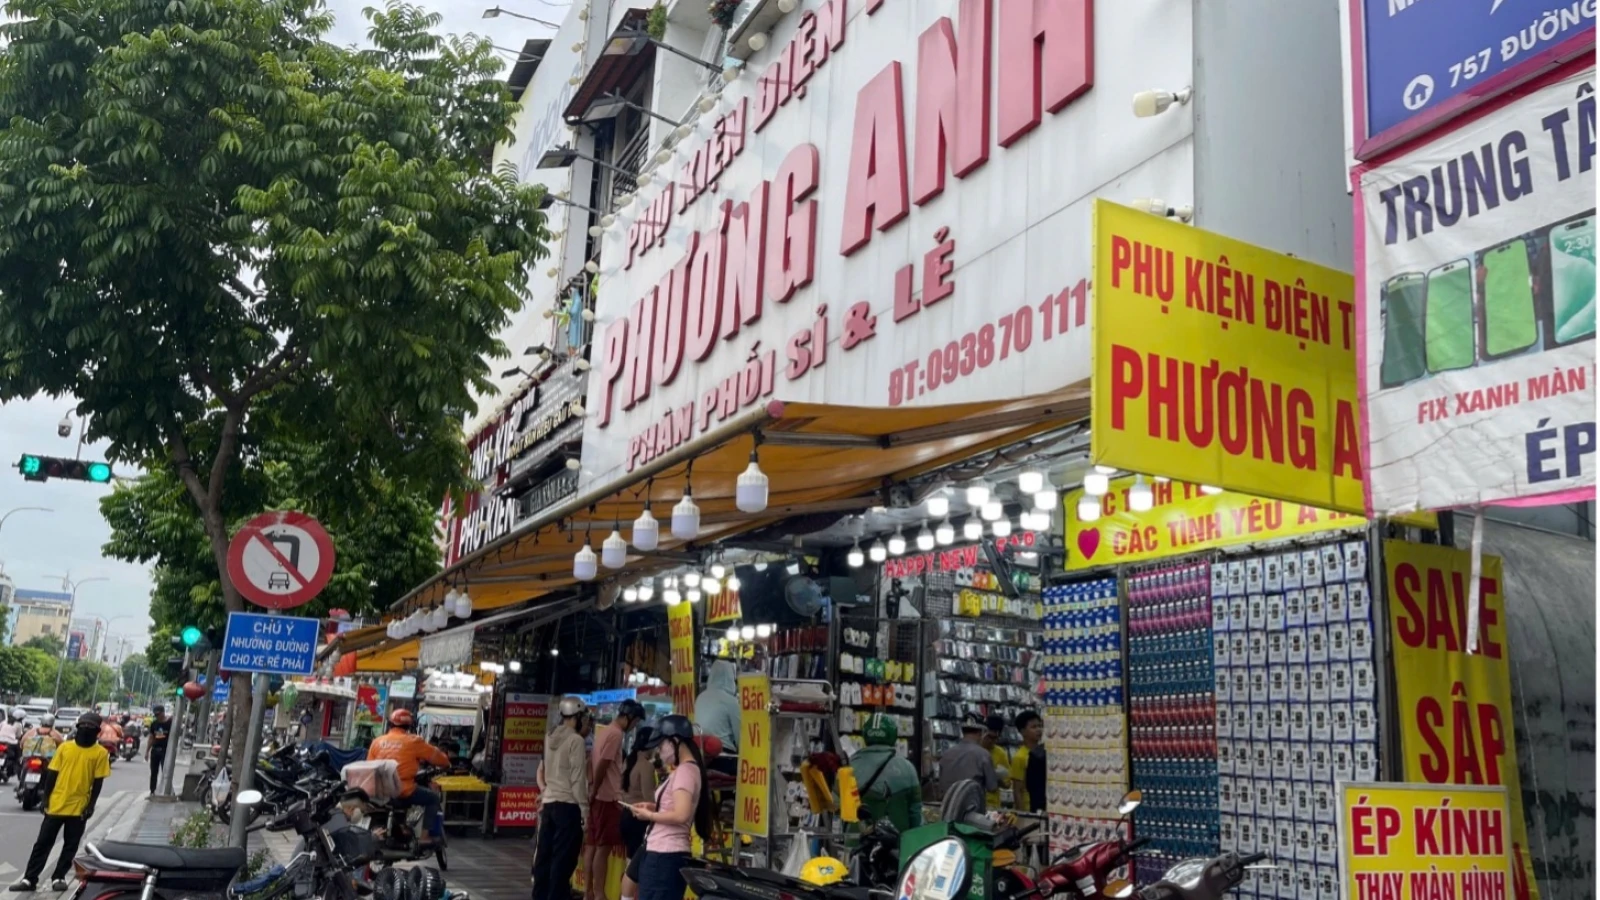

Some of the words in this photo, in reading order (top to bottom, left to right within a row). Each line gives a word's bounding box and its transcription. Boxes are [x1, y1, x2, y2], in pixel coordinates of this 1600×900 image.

[1448, 48, 1492, 88] 757
[1500, 0, 1596, 62] ĐƯỜNG
[624, 182, 674, 270] PHỤ
[678, 97, 747, 215] KIỆN
[754, 0, 846, 133] ĐIỆN
[596, 143, 820, 429] PHƯƠNG
[839, 0, 1095, 258] ANH
[1379, 130, 1533, 246] TRUNG
[999, 304, 1033, 361] 70
[1038, 278, 1092, 342] 111
[1110, 234, 1175, 314] PHỤ
[1184, 254, 1256, 330] KIỆN
[1263, 278, 1331, 350] ĐIỆN
[1338, 300, 1356, 351] T
[626, 400, 694, 472] PHÂN
[700, 340, 776, 433] PHỐI
[786, 304, 828, 381] SỈ
[839, 301, 877, 351] &
[892, 226, 956, 324] LẺ
[1110, 343, 1317, 472] PHƯƠNG
[1417, 400, 1449, 425] FIX
[1455, 382, 1520, 416] XANH
[1527, 366, 1586, 402] MÀN
[1112, 523, 1159, 556] CÁC
[1166, 512, 1222, 548] TÌNH
[1231, 499, 1283, 537] YÊU
[885, 552, 935, 578] HAPPY
[939, 545, 979, 572] NEW
[253, 619, 282, 635] CHÚ
[286, 621, 295, 636] Ý
[1394, 562, 1502, 660] SALE
[229, 653, 250, 665] CHO
[251, 655, 264, 667] XE
[267, 654, 280, 668] RẼ
[281, 655, 306, 670] PHẢI
[231, 636, 273, 652] NHƯỜNG
[275, 638, 310, 654] ĐƯỜNG
[508, 704, 525, 716] SỬA
[742, 682, 765, 712] Bán
[748, 722, 761, 749] Vì
[741, 759, 767, 787] Đam
[743, 795, 761, 825] Mê
[1350, 795, 1402, 856] ÉP
[1413, 797, 1504, 856] KÍNH
[1354, 872, 1404, 900] THAY
[1410, 864, 1456, 900] MÀN
[1461, 864, 1505, 900] HÌNH
